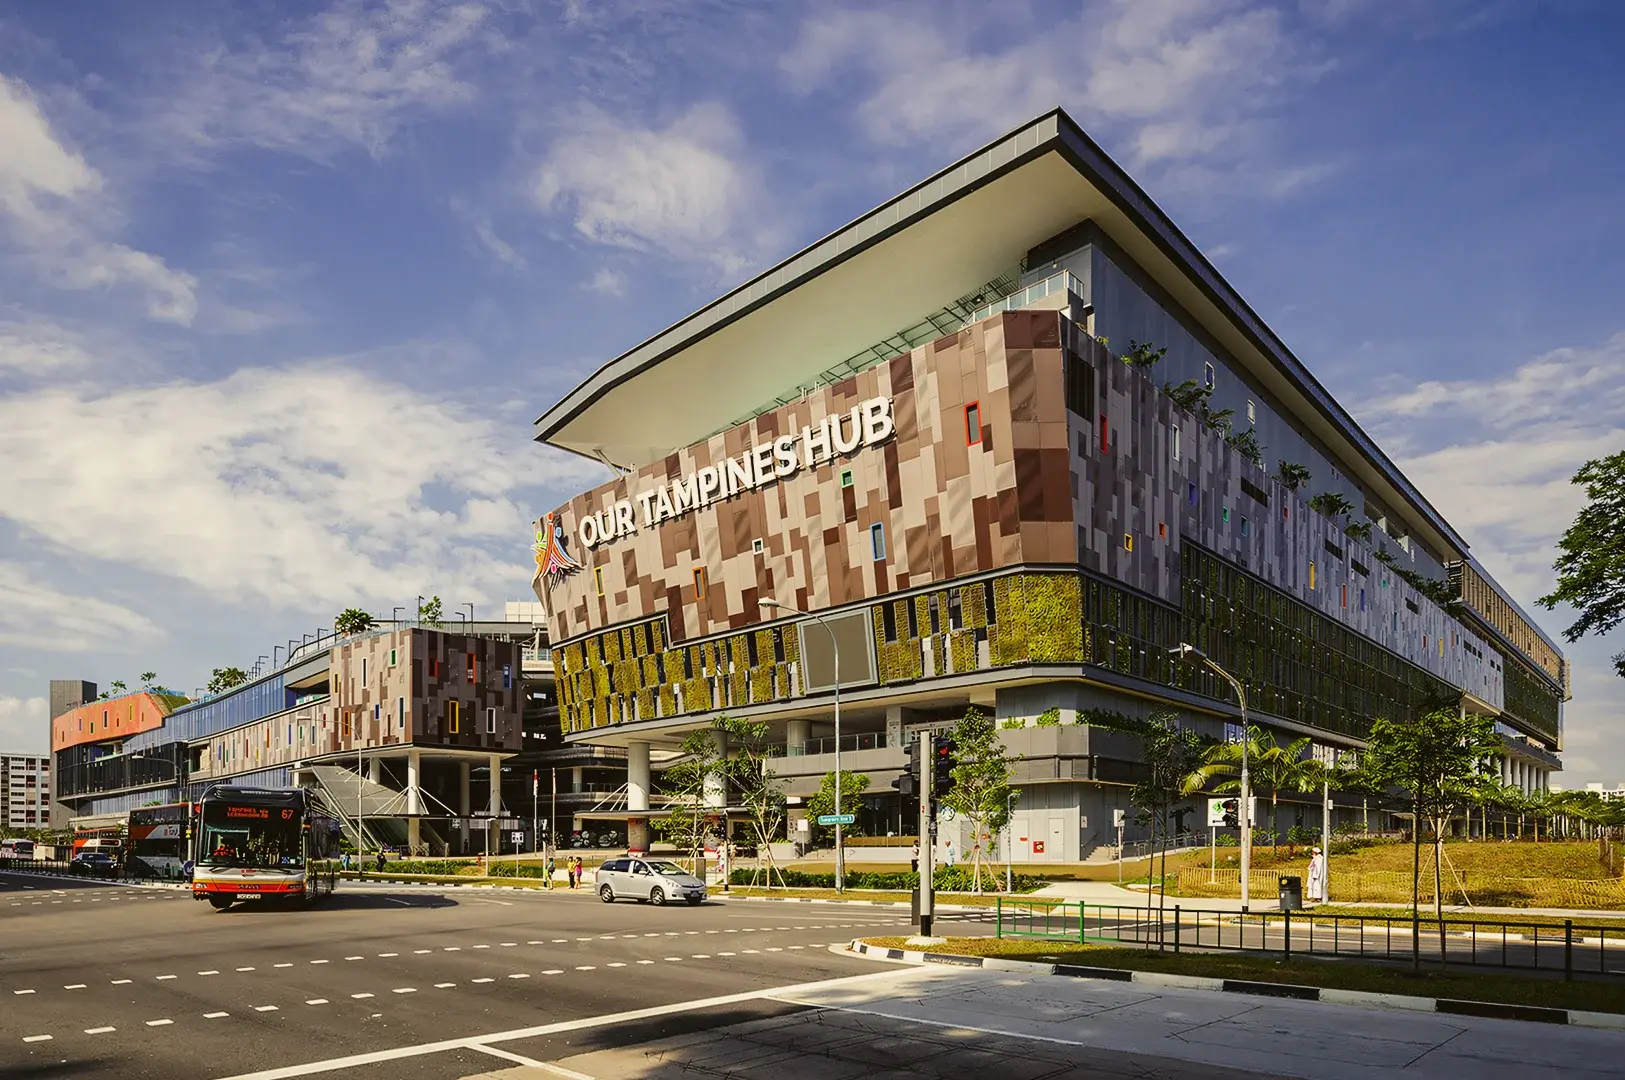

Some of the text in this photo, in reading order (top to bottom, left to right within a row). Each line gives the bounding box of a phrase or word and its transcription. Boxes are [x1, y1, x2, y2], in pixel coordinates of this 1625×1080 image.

[579, 396, 893, 547] OUR TAMPINES HUB
[281, 809, 294, 819] 67
